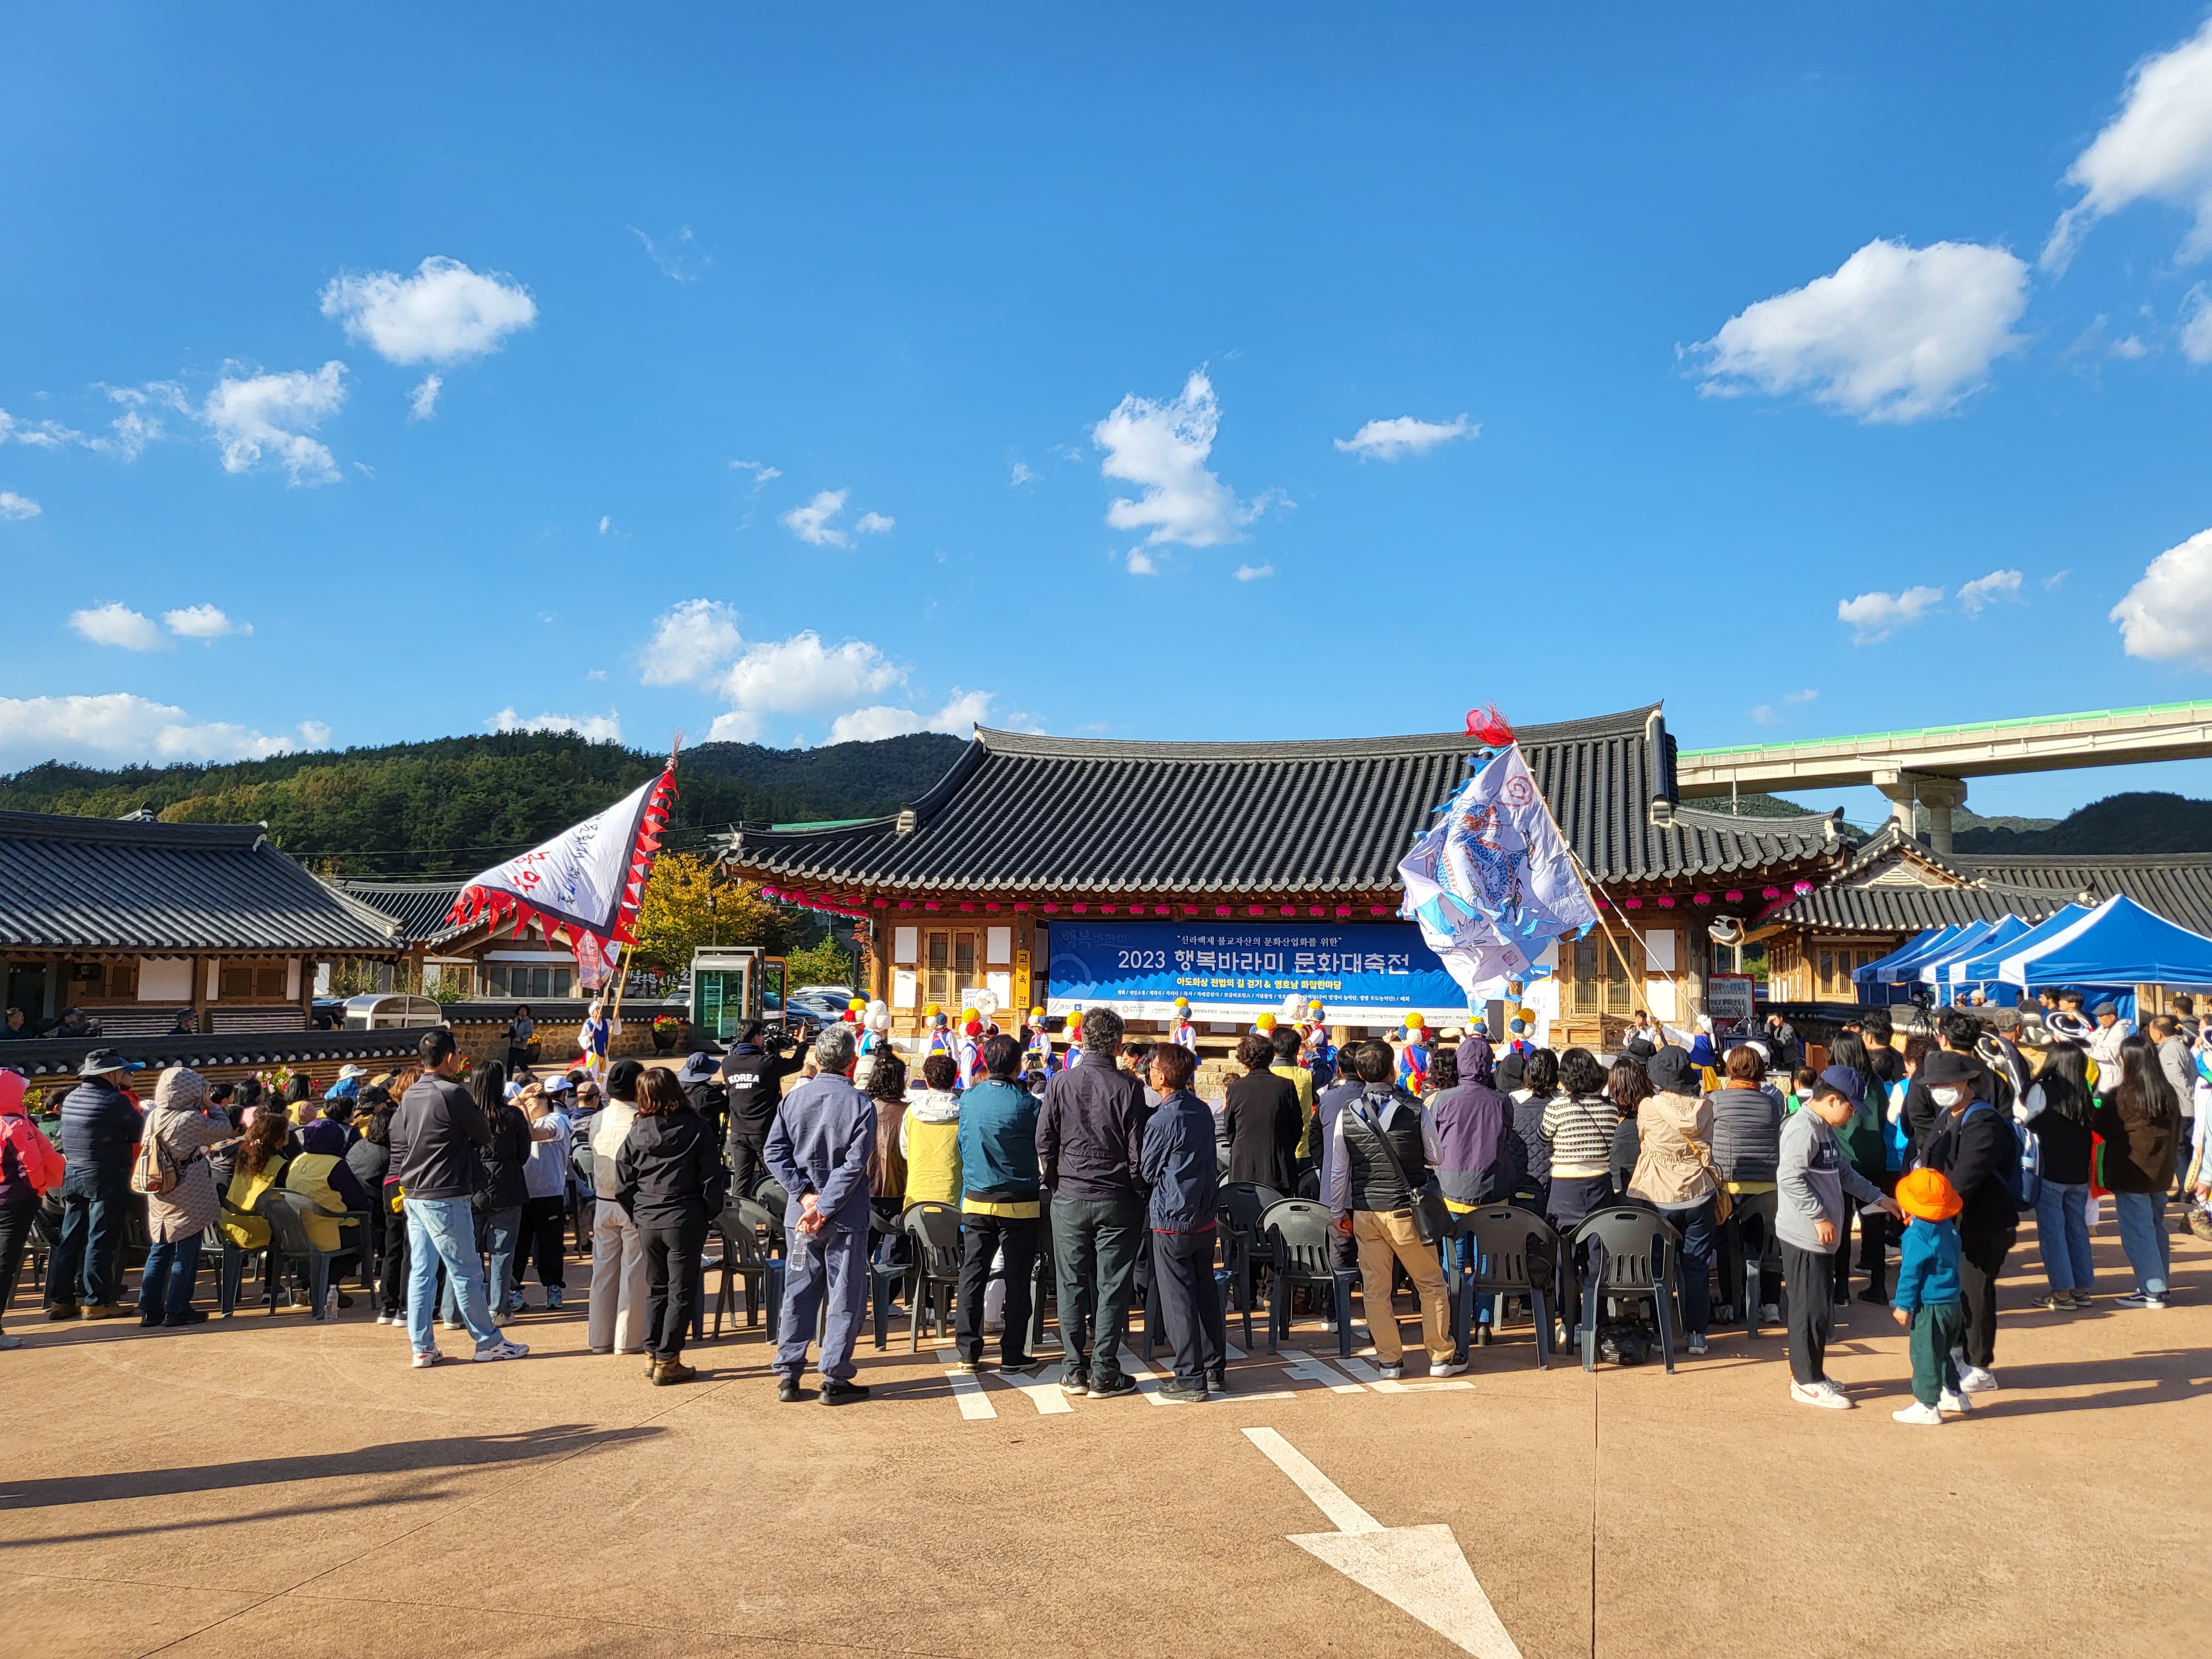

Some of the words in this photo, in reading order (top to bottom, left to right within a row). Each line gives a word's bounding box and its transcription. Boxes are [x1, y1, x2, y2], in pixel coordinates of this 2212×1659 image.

[1217, 936, 1261, 947] 불교자산의
[1263, 936, 1317, 947] 문화산업화를
[1118, 951, 1166, 969] 2023
[1174, 949, 1283, 972] 행복바라미
[1293, 952, 1409, 975] 문화대축전
[1019, 954, 1027, 1005] 교육관
[1176, 977, 1209, 987] 아도화상
[1211, 978, 1234, 988] 전법의
[1237, 978, 1244, 988] 길
[1246, 979, 1262, 989] 걷기
[1264, 980, 1271, 988] &
[1274, 980, 1299, 990] 영호남
[1301, 980, 1342, 990] 화합한마당
[727, 1073, 760, 1084] KOREA
